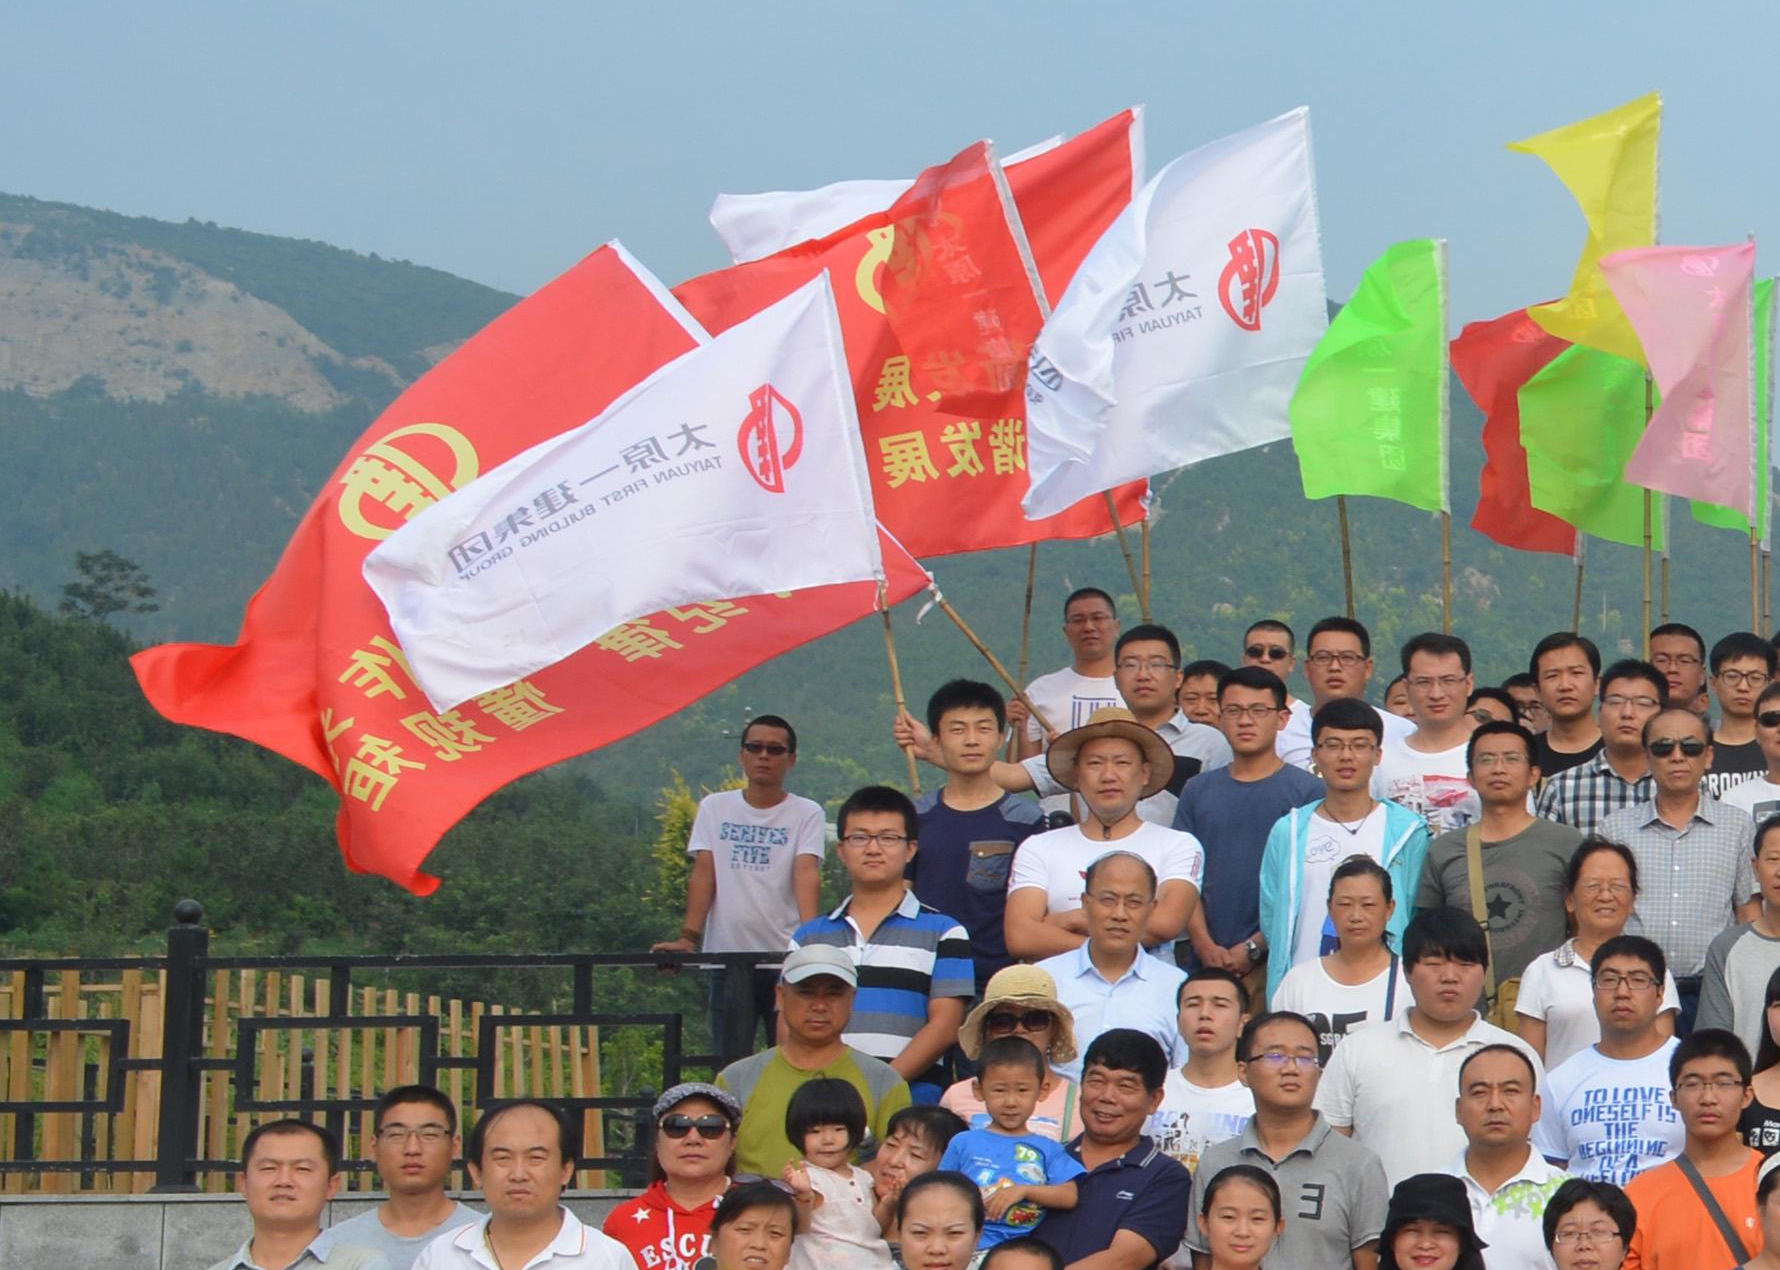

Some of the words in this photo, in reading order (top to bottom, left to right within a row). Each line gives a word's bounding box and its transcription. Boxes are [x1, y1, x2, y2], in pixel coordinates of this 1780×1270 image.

[1585, 1088, 1607, 1106] TO
[1613, 1087, 1665, 1104] LOVE
[1571, 1105, 1652, 1126] ONESELF
[1658, 1106, 1676, 1124] IS
[1604, 1122, 1638, 1139] THE
[1578, 1139, 1669, 1160] BEGINNING
[1626, 1154, 1638, 1168] A
